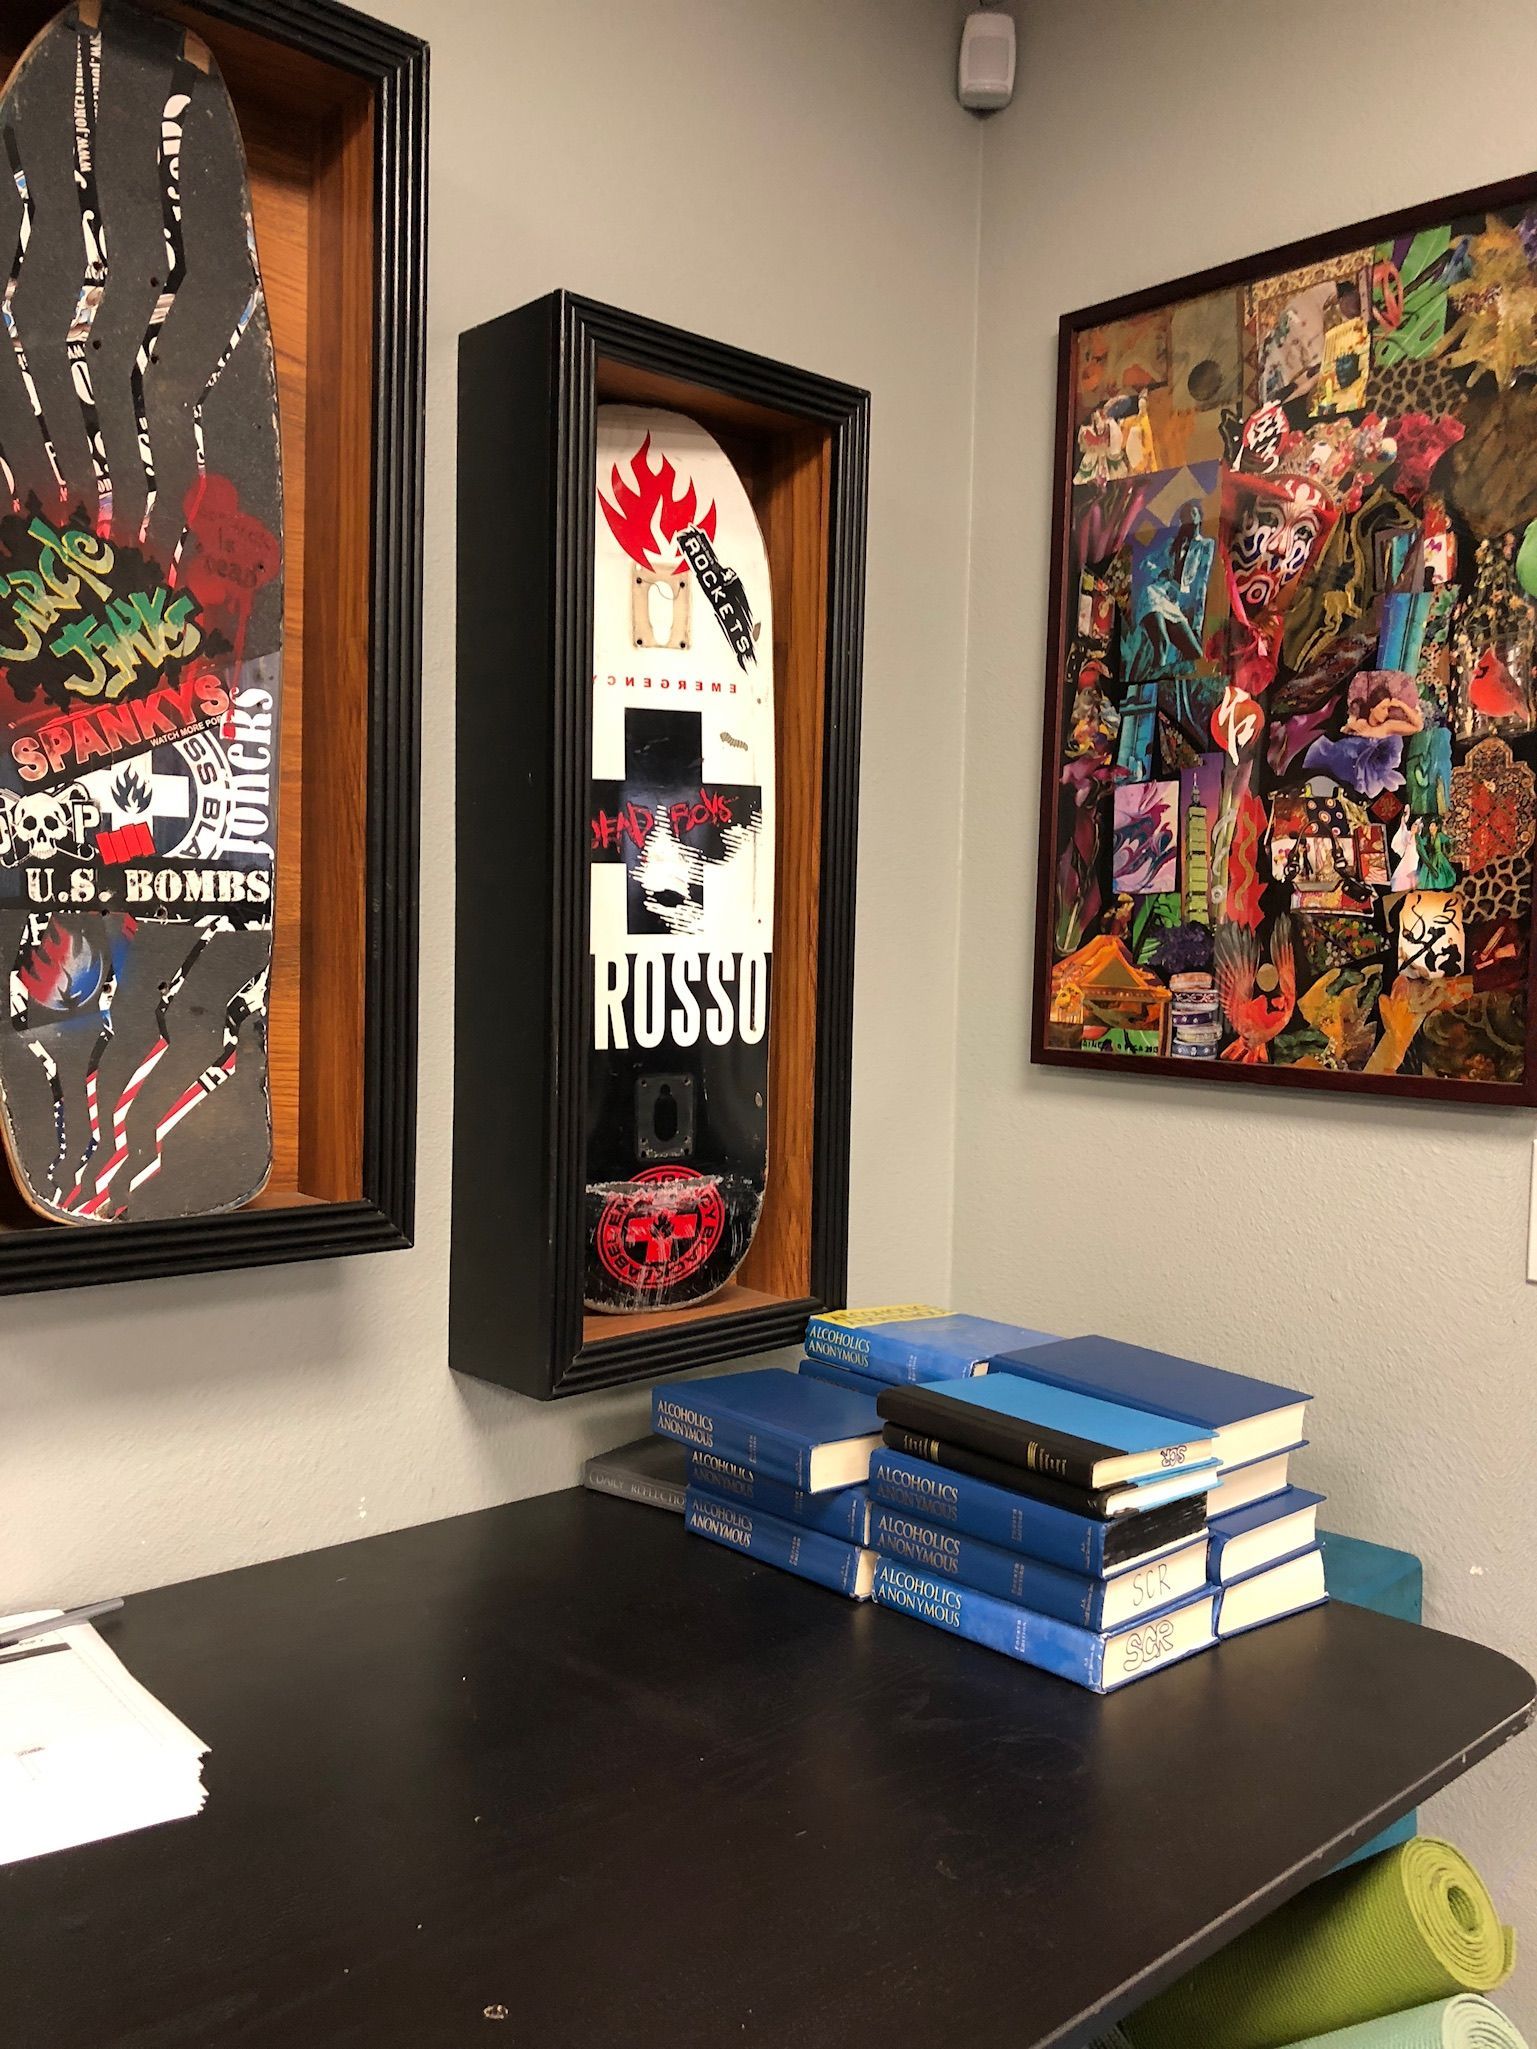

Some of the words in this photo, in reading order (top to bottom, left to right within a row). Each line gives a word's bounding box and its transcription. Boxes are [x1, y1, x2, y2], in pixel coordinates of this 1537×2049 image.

[684, 536, 751, 654] ROCKETS
[10, 674, 230, 783] SPANKYS
[150, 730, 181, 747] WATCH
[180, 722, 206, 737] MORE
[25, 868, 111, 902] U.S.
[124, 868, 271, 902] BOMBS
[594, 952, 768, 1051] ROSSO
[808, 1339, 869, 1368] ANONYMOUS
[809, 1325, 872, 1354] ALCOHOLICS
[657, 1399, 714, 1432] ALCOHOLICS
[657, 1415, 714, 1448] ANONYMOUS
[692, 1450, 755, 1483] ALCOHOLICS
[693, 1466, 754, 1498] ANONYMOUS
[876, 1464, 959, 1505] ALCOHOLICS
[631, 1484, 685, 1506] REFLECTIO
[877, 1482, 958, 1522] ANONYMOUS
[690, 1512, 752, 1548] ANONYMOUS
[692, 1499, 753, 1532] ALCOHOLICS
[877, 1532, 959, 1574] ANONYMOUS
[878, 1514, 961, 1556] ALCOHOLICS
[879, 1565, 962, 1611] ALCOHOLICS
[1133, 1564, 1171, 1607] SCR
[877, 1582, 961, 1629] ANONYMOUS
[1122, 1618, 1174, 1673] SCR
